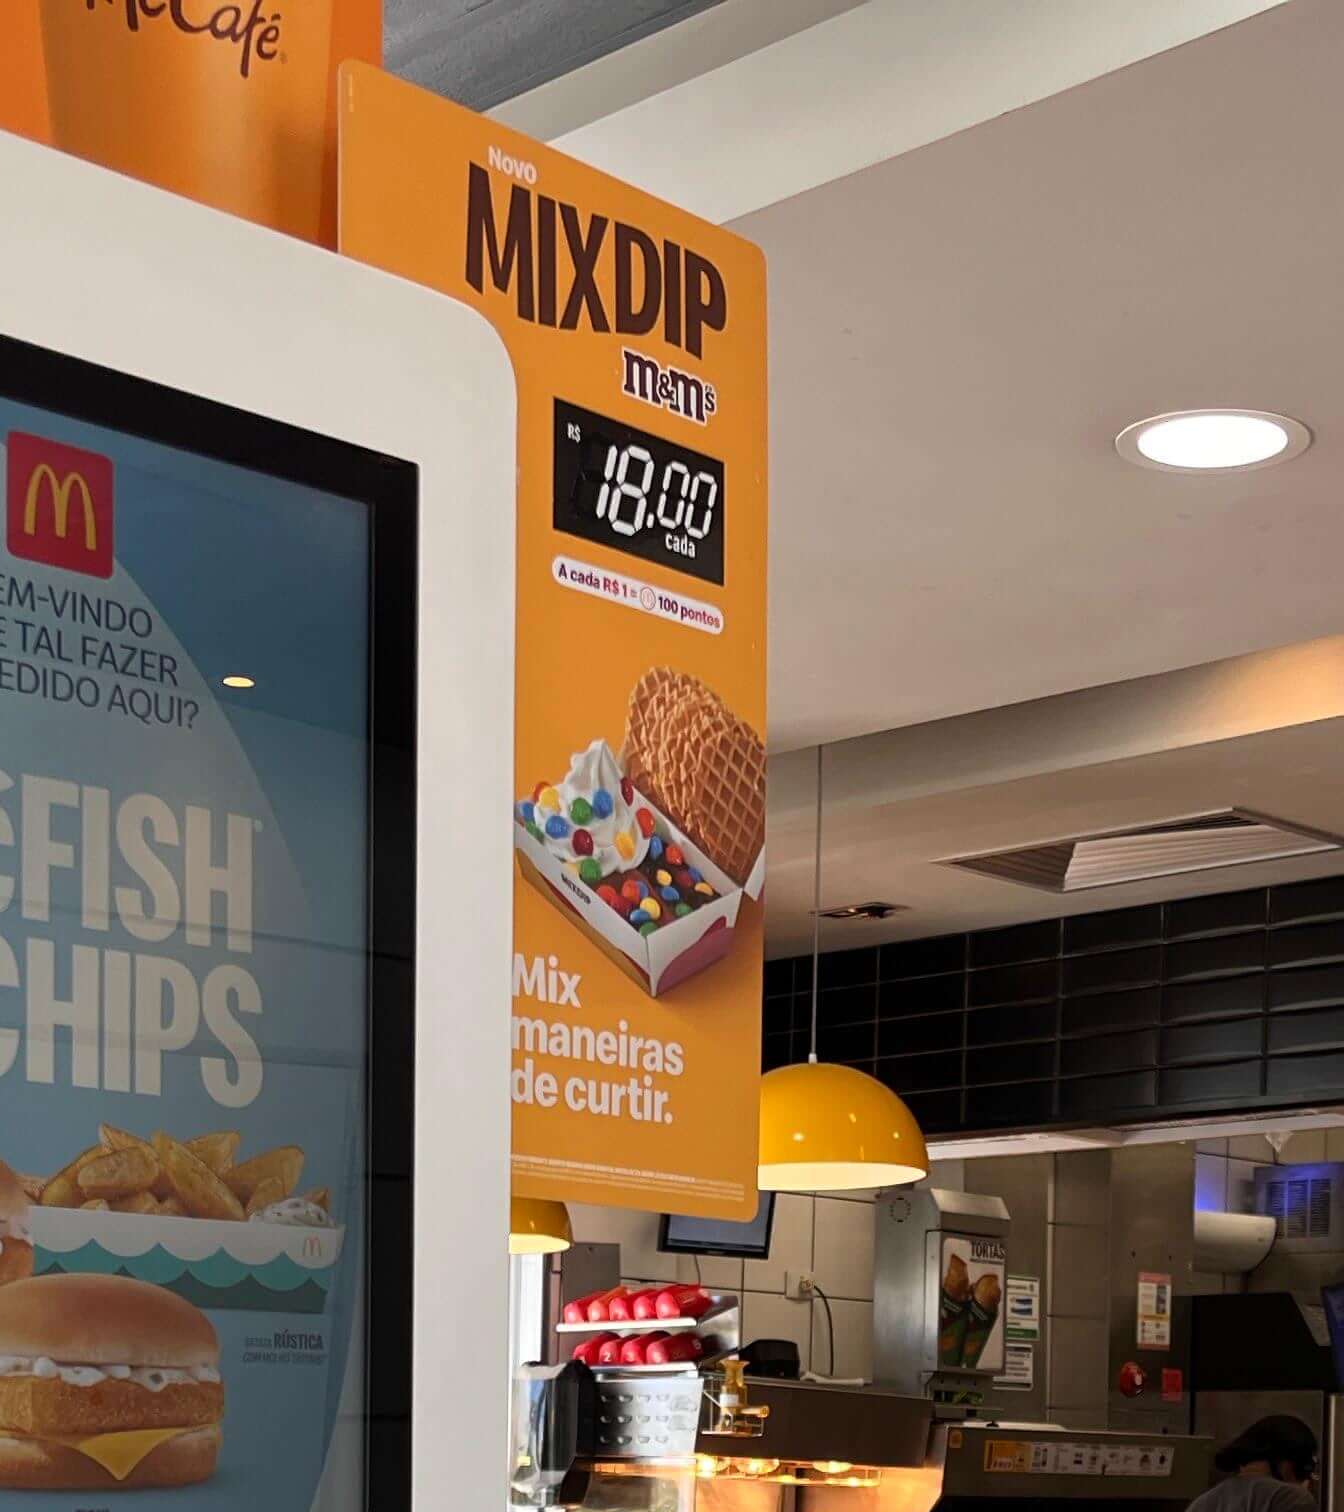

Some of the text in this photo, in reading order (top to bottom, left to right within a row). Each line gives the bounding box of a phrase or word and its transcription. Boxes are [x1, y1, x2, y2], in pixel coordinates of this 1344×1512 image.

[488, 146, 537, 184] Novo
[465, 160, 727, 361] MIXDIP
[567, 422, 581, 443] R$
[666, 533, 696, 558] cada
[558, 563, 568, 579] A
[570, 568, 600, 589] cada
[658, 595, 678, 614] 100
[680, 603, 721, 629] pontos
[14, 620, 73, 662] TAL
[82, 636, 179, 687] FAZER
[108, 683, 200, 730] AQUI?
[512, 953, 582, 1008] Mix
[511, 1015, 684, 1076] maneiras
[511, 1058, 673, 1124] de curtir.
